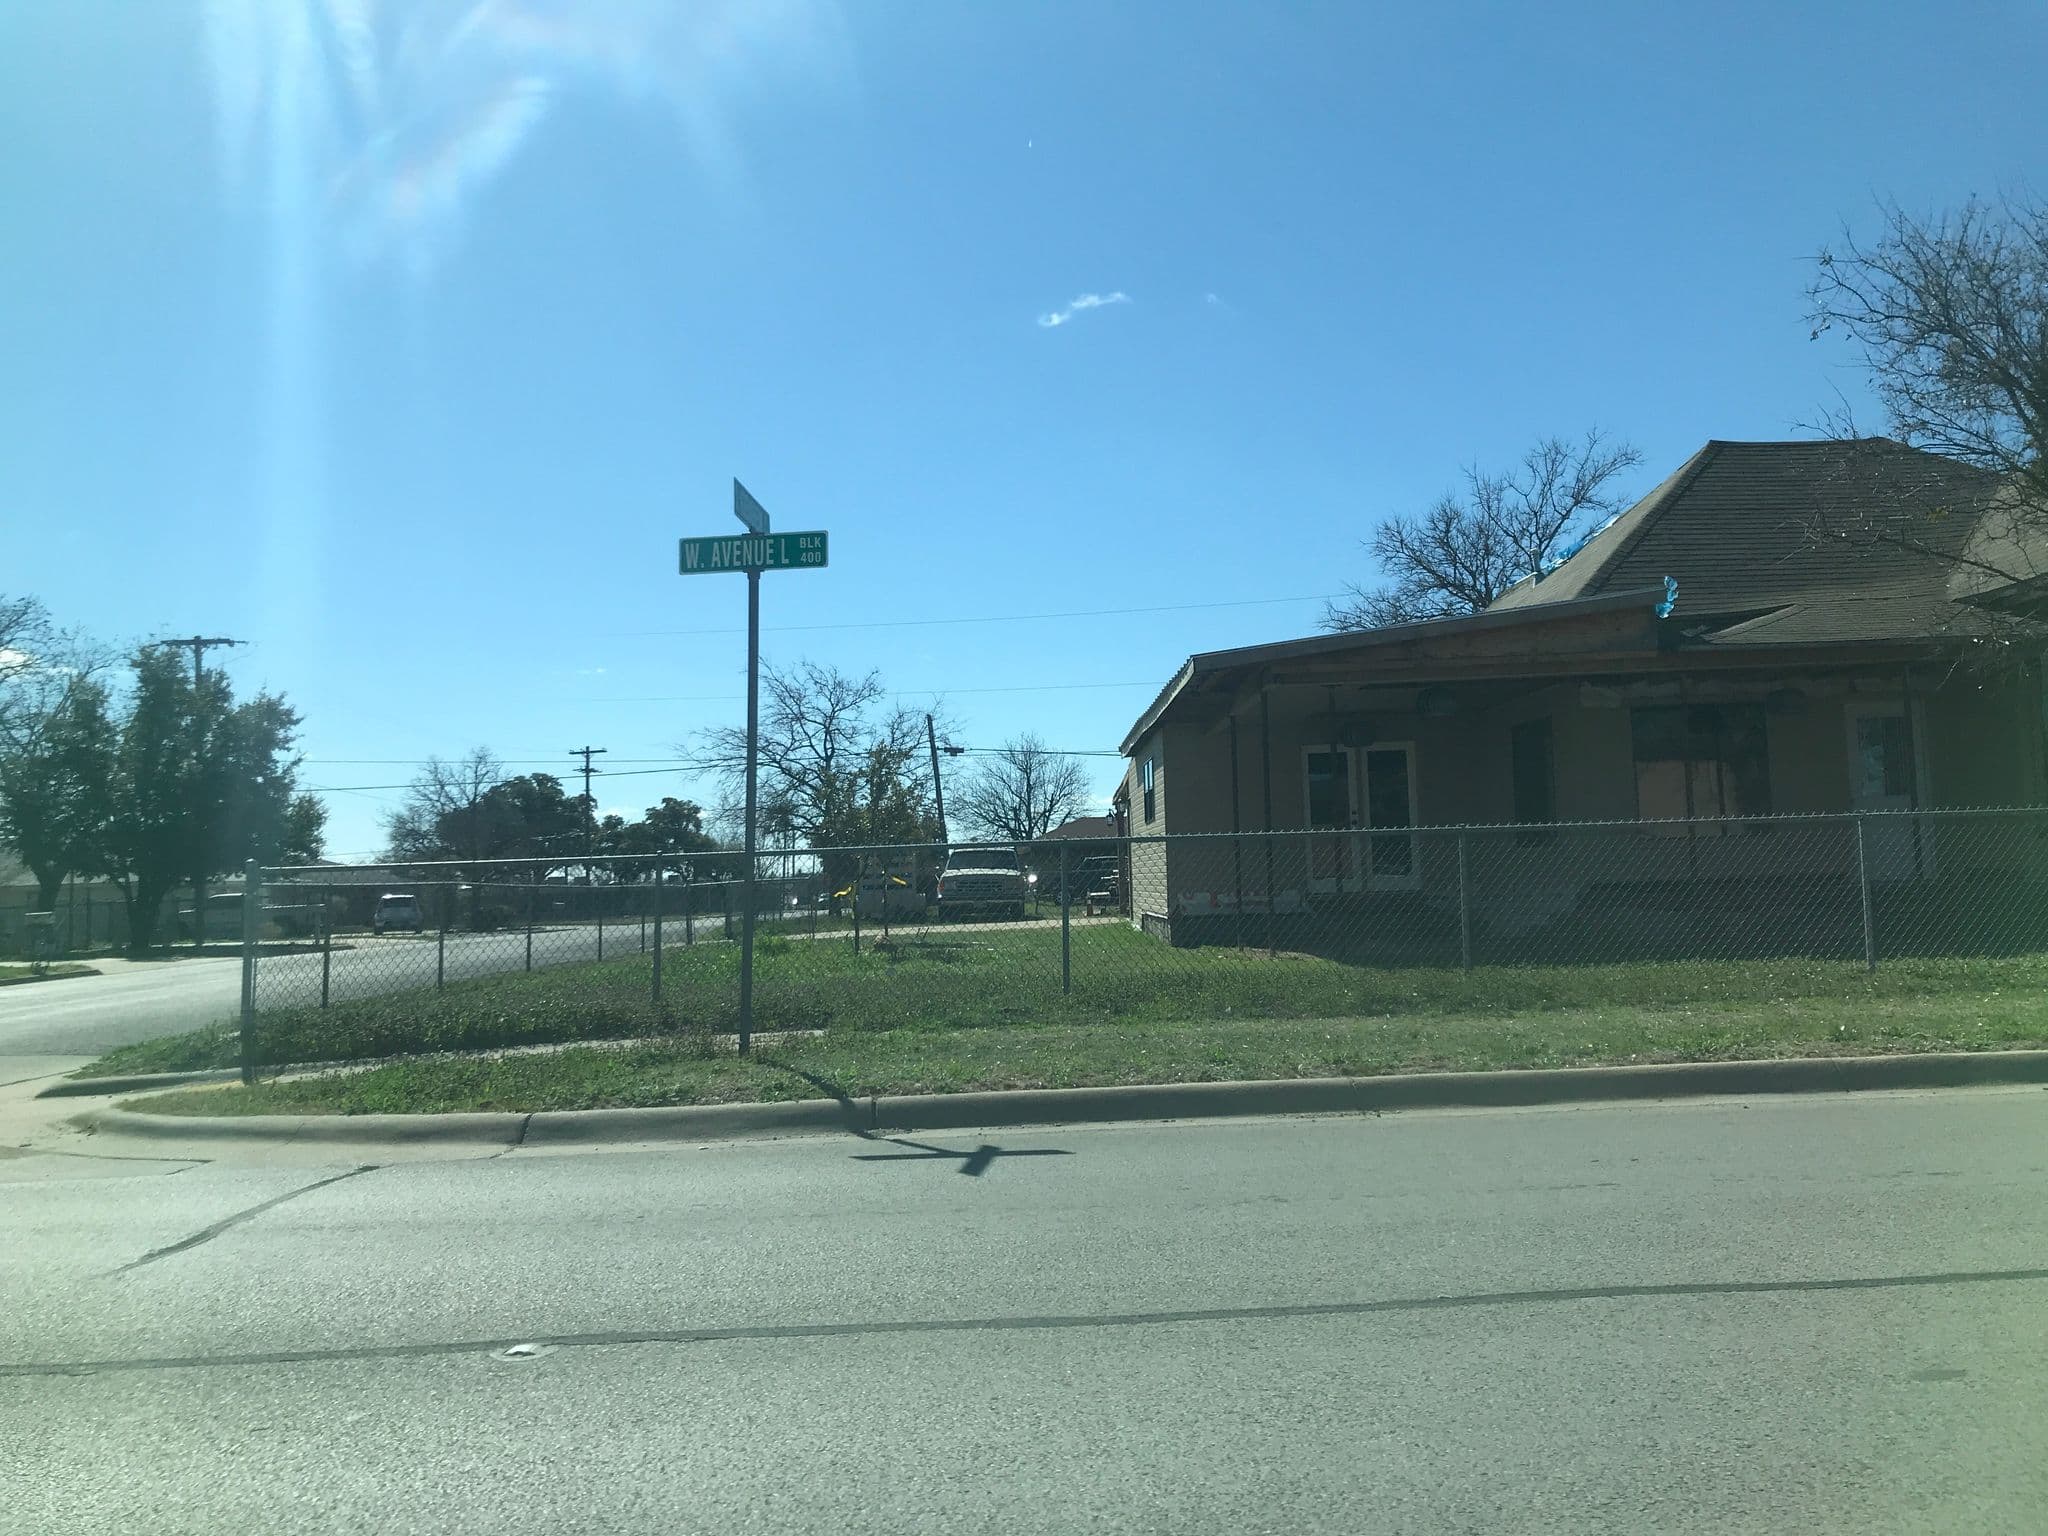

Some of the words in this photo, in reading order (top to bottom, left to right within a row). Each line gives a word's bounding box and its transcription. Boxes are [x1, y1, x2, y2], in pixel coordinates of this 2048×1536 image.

[799, 537, 822, 549] BLK
[685, 543, 705, 569] W.
[711, 538, 775, 567] AVENUE
[781, 538, 790, 564] L
[799, 551, 822, 564] 400
